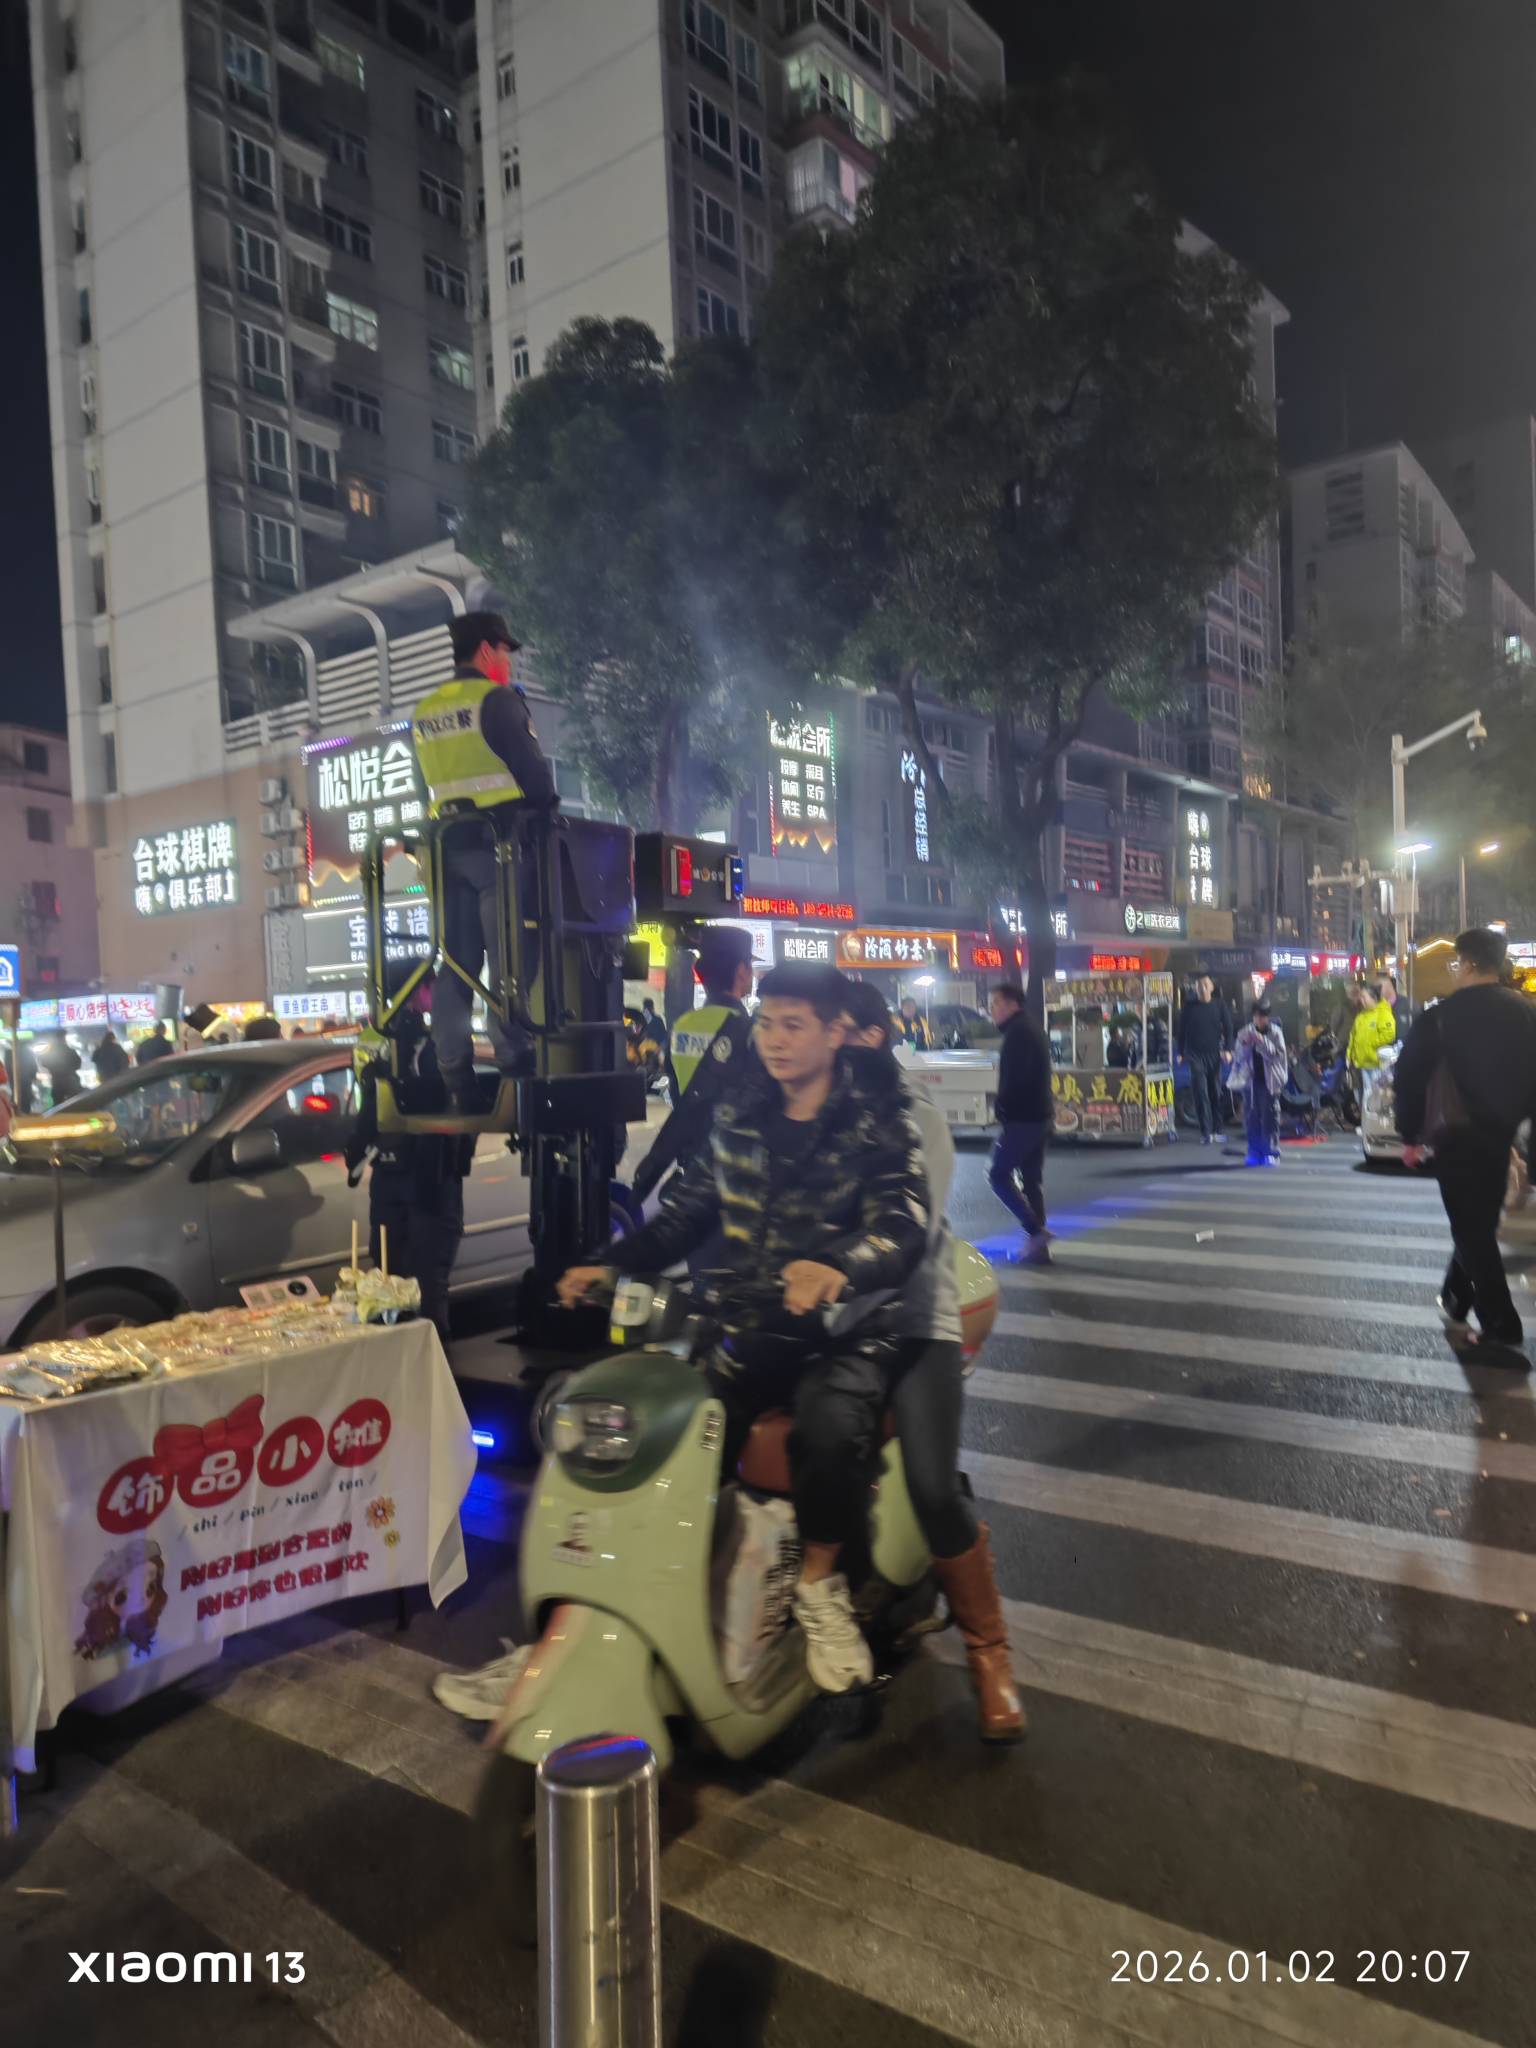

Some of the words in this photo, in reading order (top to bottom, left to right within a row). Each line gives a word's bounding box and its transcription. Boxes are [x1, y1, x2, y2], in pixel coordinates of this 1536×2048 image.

[317, 739, 416, 811] 松悦会
[806, 804, 828, 821] SPA
[132, 821, 234, 884] 台球棋牌
[1188, 843, 1212, 872] 台球
[783, 938, 829, 960] 松悦会所
[239, 1504, 265, 1522] pin
